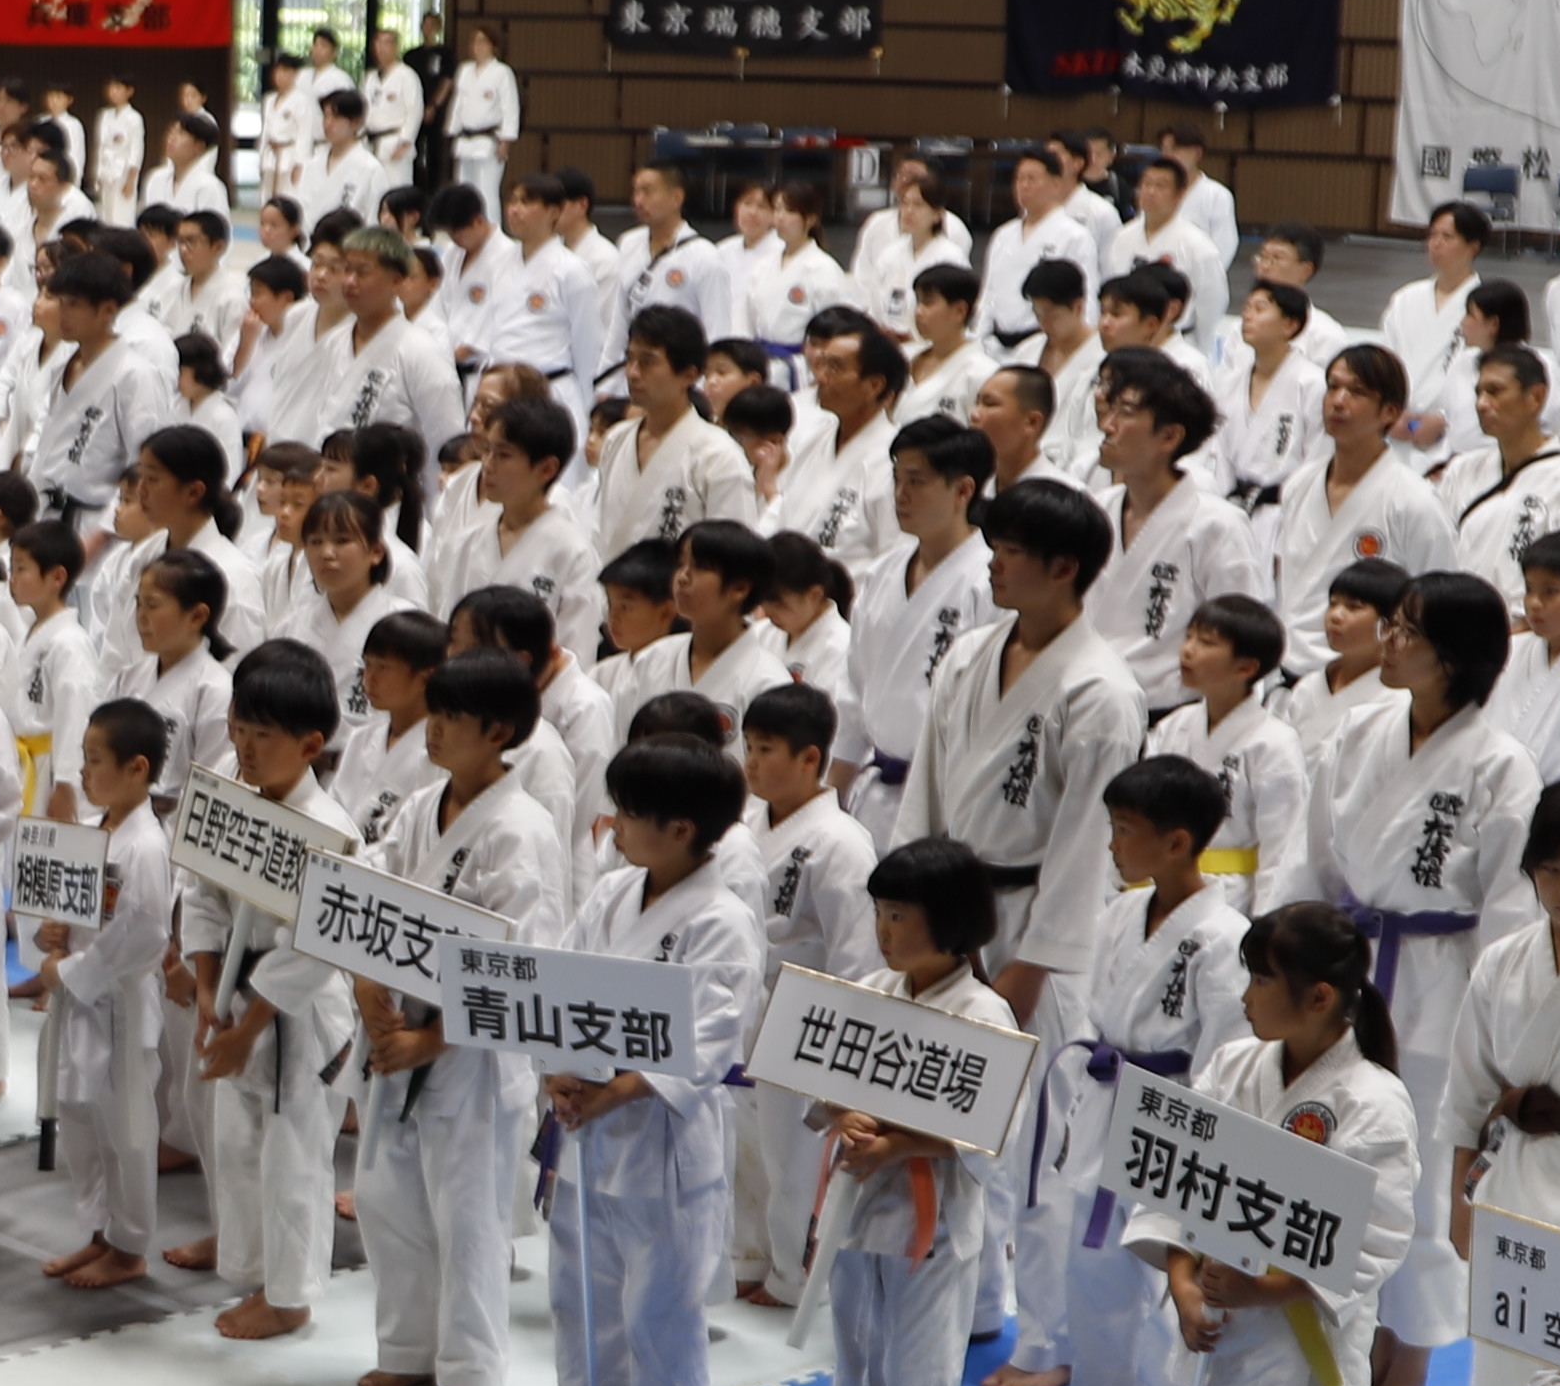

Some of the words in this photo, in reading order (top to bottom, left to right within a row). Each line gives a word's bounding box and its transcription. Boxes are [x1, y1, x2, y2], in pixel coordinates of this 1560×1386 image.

[183, 789, 309, 895] 日野空手道教
[16, 852, 100, 916] 相模原支部
[316, 883, 482, 983] 赤坂支
[461, 947, 538, 983] 東京都
[461, 985, 674, 1063] 青山支部
[791, 1004, 988, 1115] 世田谷道場
[1136, 1084, 1219, 1142] 東京都
[1124, 1126, 1343, 1272] 羽村支部
[1494, 1234, 1547, 1271] 東京都
[1494, 1286, 1529, 1327] ai
